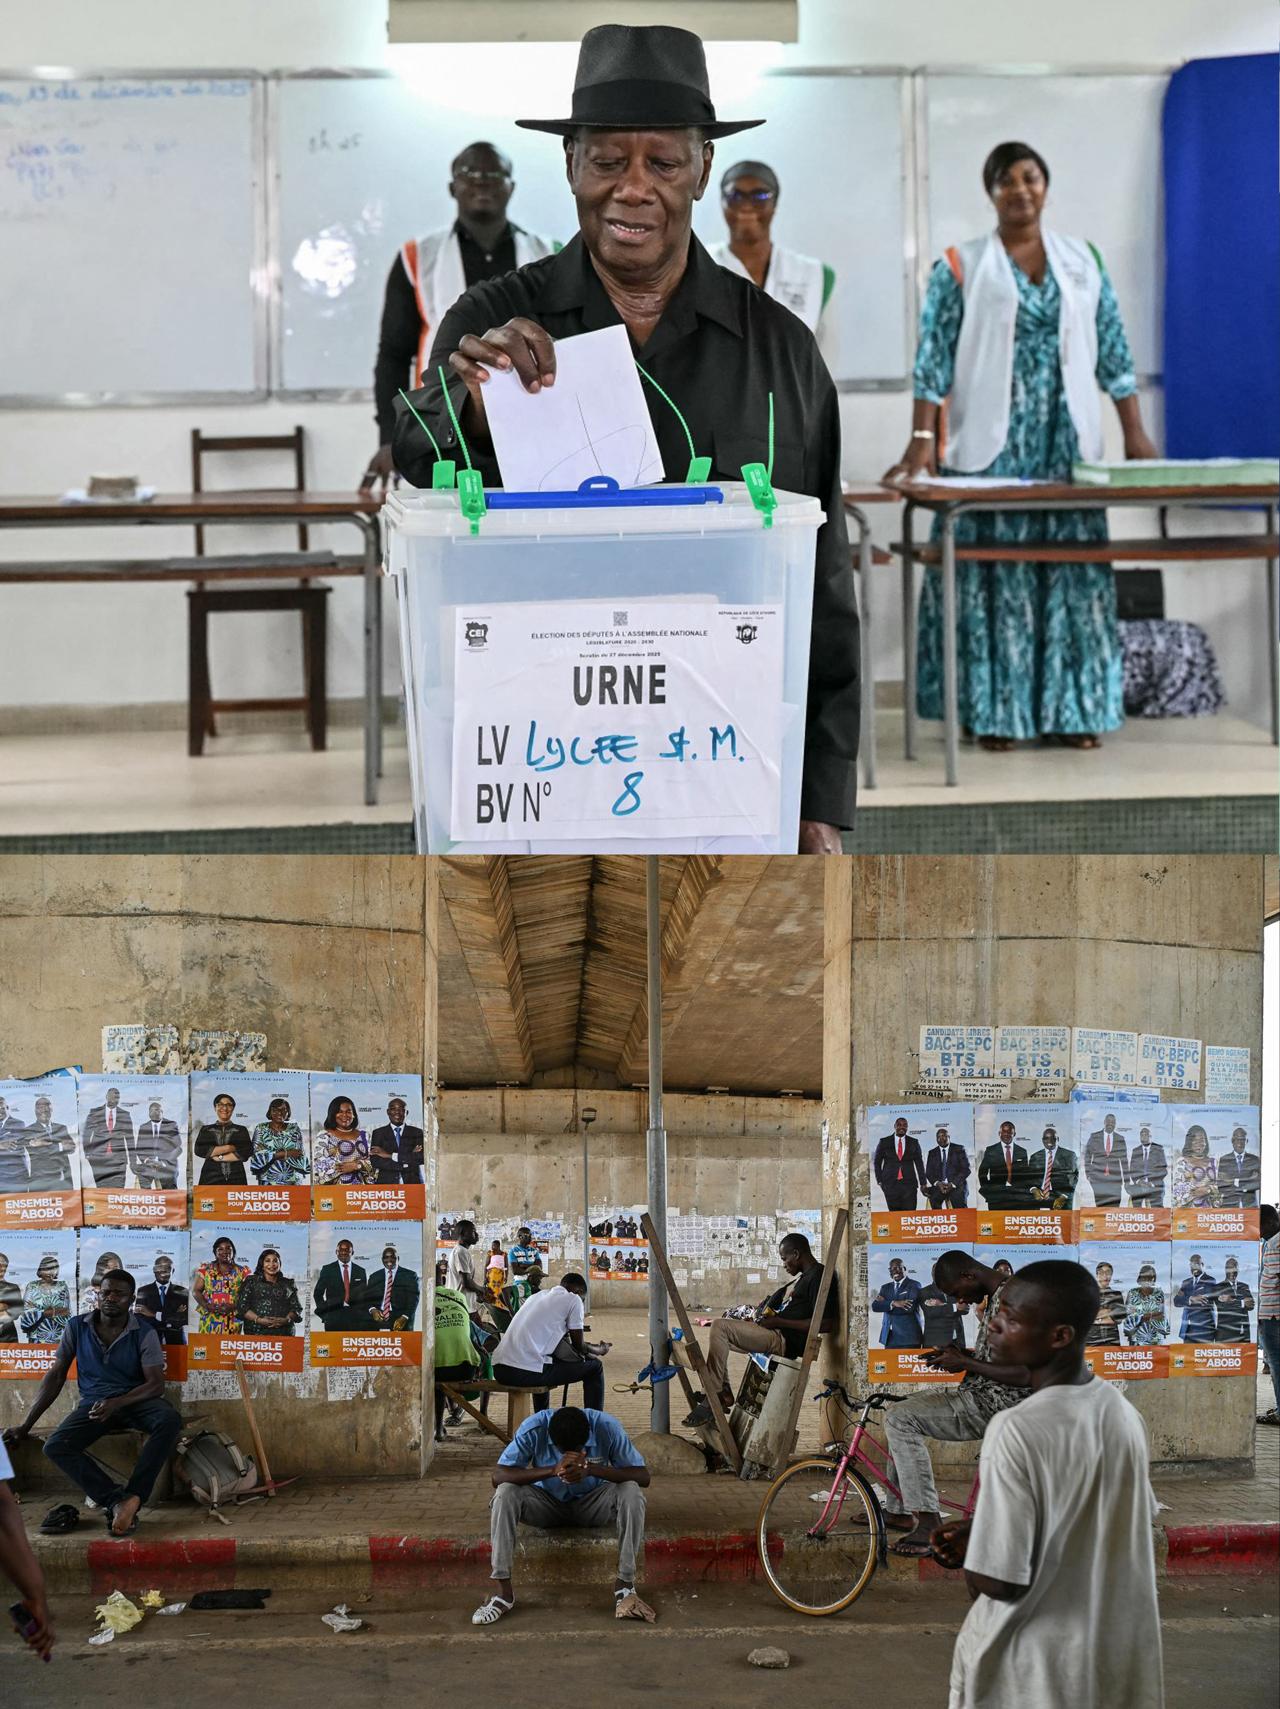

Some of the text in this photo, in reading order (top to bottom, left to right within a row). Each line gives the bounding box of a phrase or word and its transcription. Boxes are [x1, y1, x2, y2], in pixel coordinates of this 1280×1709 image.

[469, 629, 485, 638] CEI
[531, 632, 566, 640] ÉLECTION
[622, 629, 668, 637] L'ASSEMBLÉE
[573, 663, 667, 706] URNE
[477, 725, 510, 766] LV
[476, 771, 644, 824] BV N° 8
[925, 1036, 992, 1051] BAC-BEPC
[1000, 1037, 1068, 1051] BAC-BEPC
[1077, 1039, 1135, 1056] BAC-BEPC
[941, 1052, 976, 1067] BTS
[1142, 1045, 1199, 1063] BAC-BEPC
[1016, 1053, 1052, 1067] BTS
[1090, 1056, 1121, 1071] BTS
[925, 1068, 937, 1077] 41
[960, 1068, 974, 1077] 32
[978, 1068, 990, 1077] 41
[1000, 1068, 1013, 1077] 41
[1036, 1068, 1050, 1077] 32
[1053, 1068, 1066, 1077] 41
[1155, 1062, 1185, 1077] BTS
[1076, 1070, 1087, 1079] 41
[1107, 1072, 1120, 1081] 32
[1122, 1074, 1134, 1082] 41
[1141, 1075, 1152, 1084] 41
[1171, 1078, 1184, 1087] 32
[1186, 1080, 1197, 1089] 41
[107, 1195, 166, 1205] ENSEMBLE
[227, 1191, 290, 1201] ENSEMBLE
[346, 1190, 405, 1200] ENSEMBLE
[6, 1198, 63, 1209] ENSEMBLE
[243, 1201, 291, 1212] ABOBO
[361, 1200, 406, 1211] ABOBO
[20, 1208, 64, 1219] ABOBO
[122, 1205, 166, 1216] ABOBO
[900, 1214, 957, 1225] ENSEMBLE
[1004, 1216, 1061, 1225] ENSEMBLE
[1105, 1213, 1154, 1222] ENSEMBLE
[1197, 1214, 1244, 1222] ENSEMBLE
[915, 1224, 958, 1235] ABOBO
[1019, 1225, 1062, 1235] ABOBO
[1117, 1223, 1155, 1233] ABOBO
[1209, 1223, 1245, 1233] ABOBO
[220, 1340, 283, 1351] ENSEMBLE
[342, 1337, 402, 1347] ENSEMBLE
[0, 1349, 57, 1359] ENSEMBLE
[236, 1351, 283, 1362] ABOBO
[358, 1347, 403, 1357] ABOBO
[1104, 1351, 1153, 1360] ENSEMBLE
[1194, 1348, 1242, 1357] ENSEMBLE
[1116, 1361, 1153, 1371] ABOBO
[1206, 1358, 1242, 1368] ABOBO
